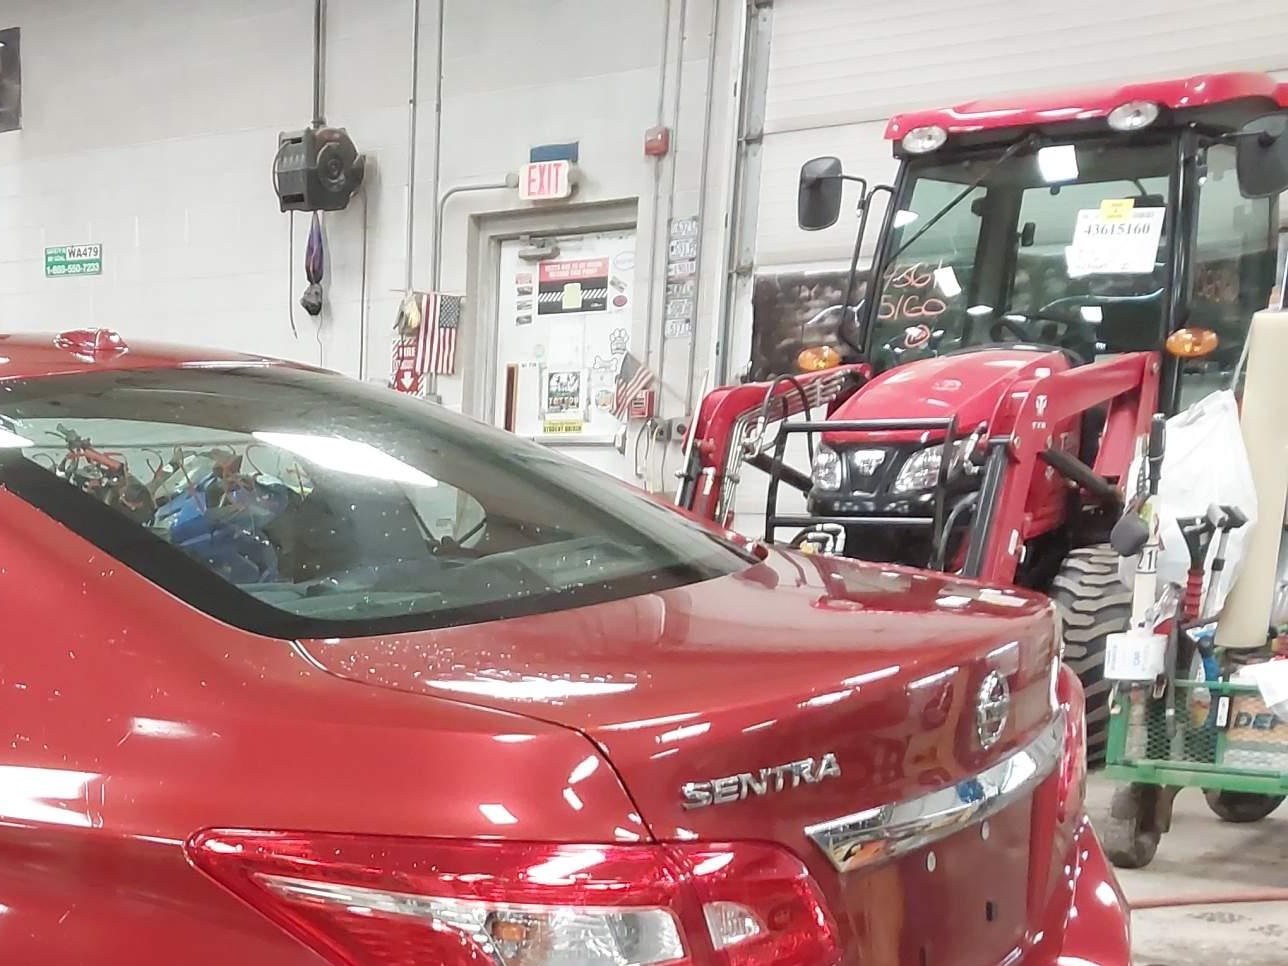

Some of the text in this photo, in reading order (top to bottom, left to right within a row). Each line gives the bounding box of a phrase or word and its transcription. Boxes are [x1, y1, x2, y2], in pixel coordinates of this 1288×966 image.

[527, 163, 562, 197] EXIT
[1083, 223, 1151, 236] 43615160
[67, 247, 98, 258] WA479
[681, 752, 841, 811] SENTRA
